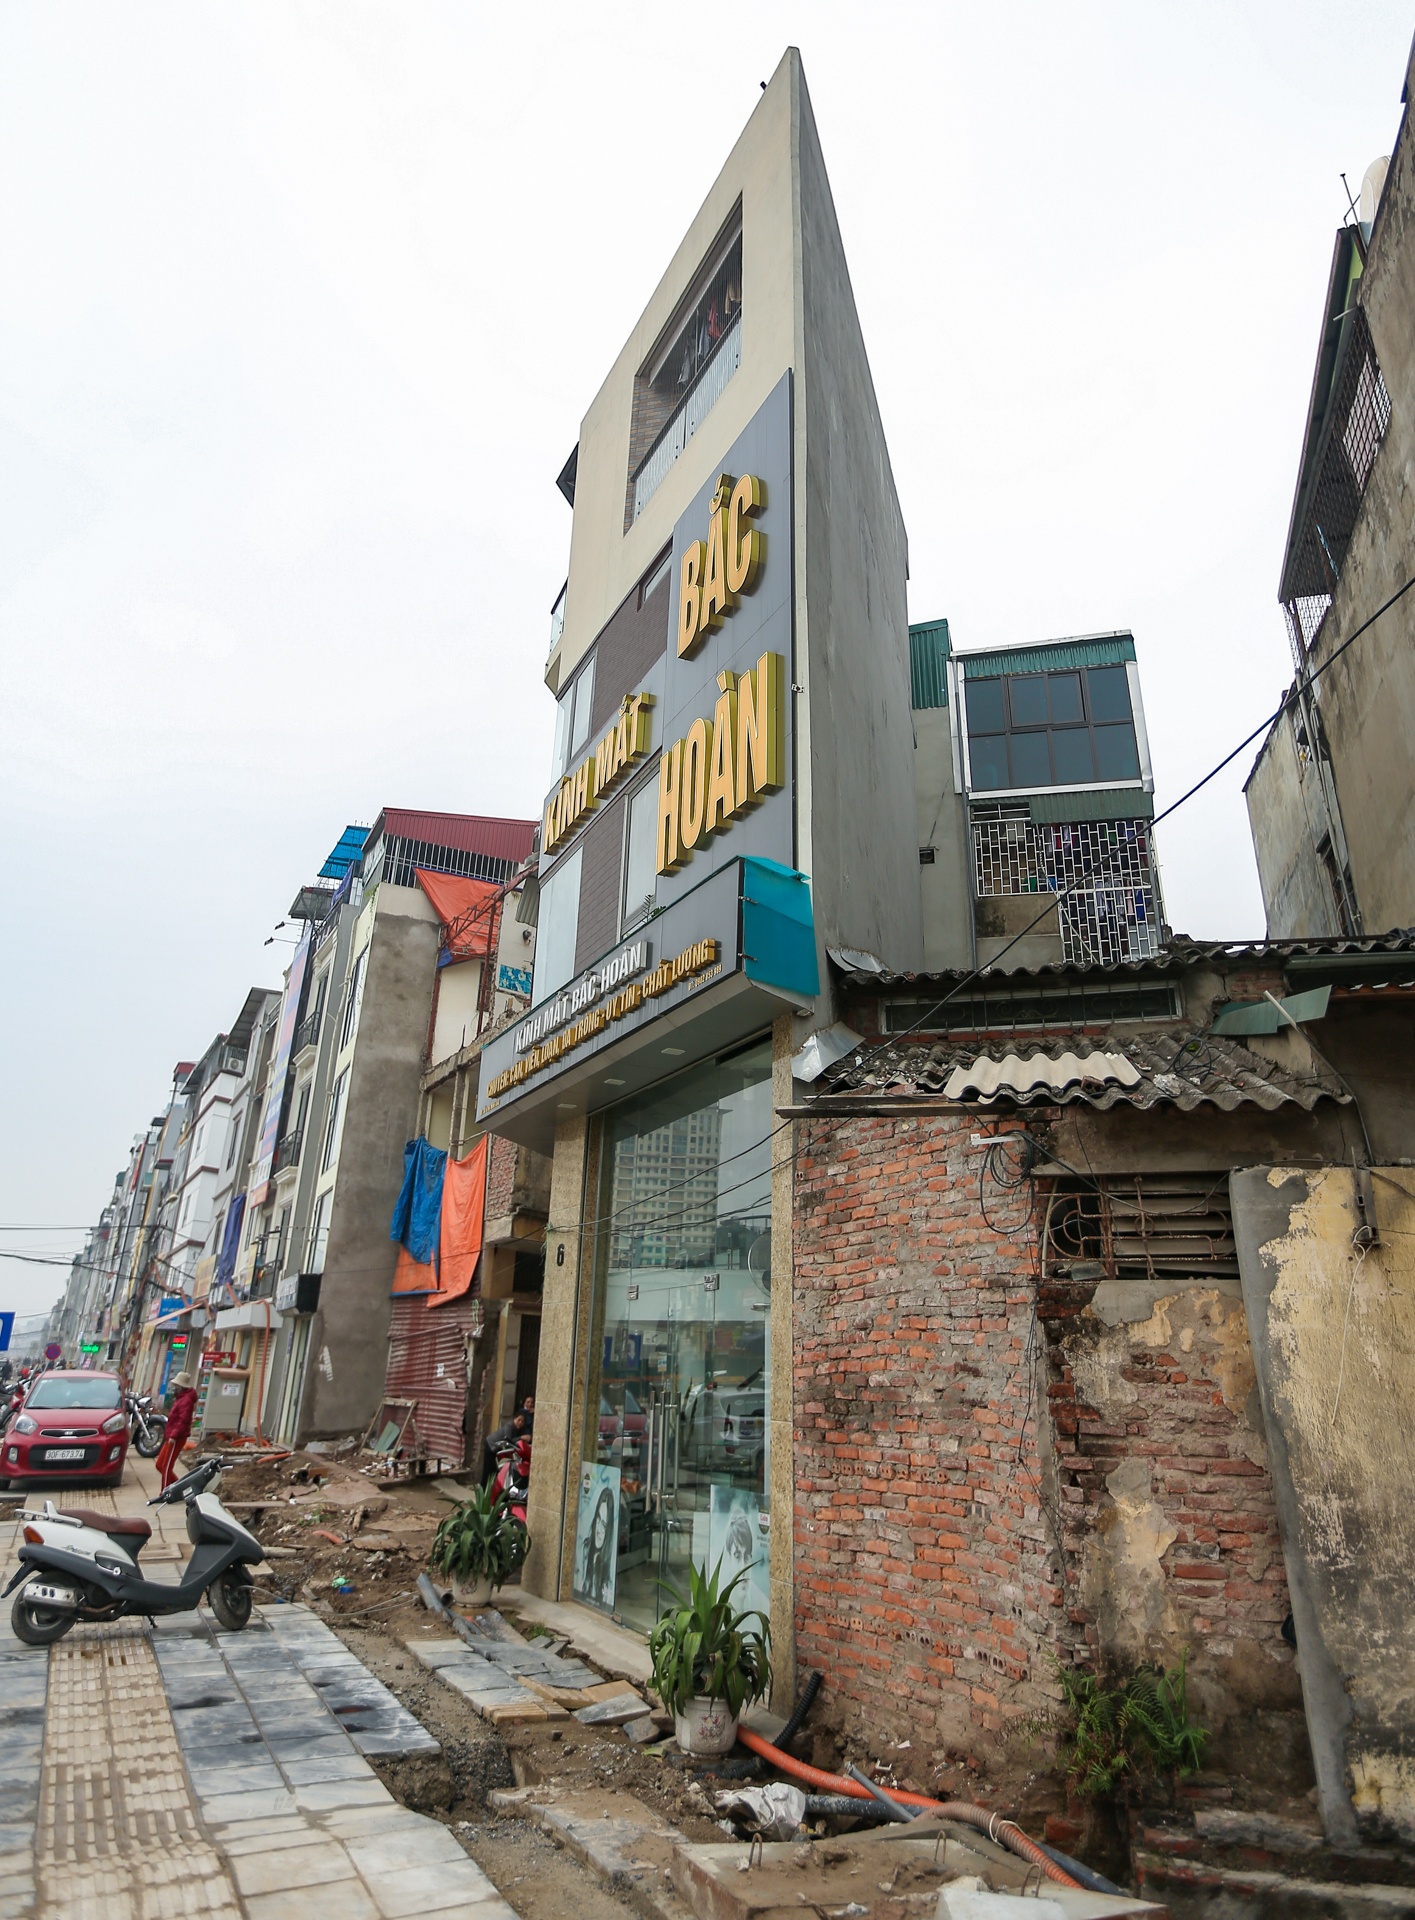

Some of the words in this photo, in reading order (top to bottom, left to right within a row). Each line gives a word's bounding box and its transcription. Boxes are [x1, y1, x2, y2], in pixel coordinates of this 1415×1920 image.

[677, 474, 758, 659] BẮC
[544, 757, 594, 854] KÍNH
[593, 692, 652, 798] MẮT
[656, 652, 778, 875] HOÀN
[516, 1020, 542, 1053] KÍNH
[543, 991, 570, 1032] MẮT
[571, 970, 599, 1014] BẮC
[601, 941, 645, 993] HOÀN
[606, 996, 619, 1020] UY
[621, 984, 638, 1013] TÍN
[643, 959, 671, 997] CHẤT
[672, 938, 713, 980] LƯỢNG
